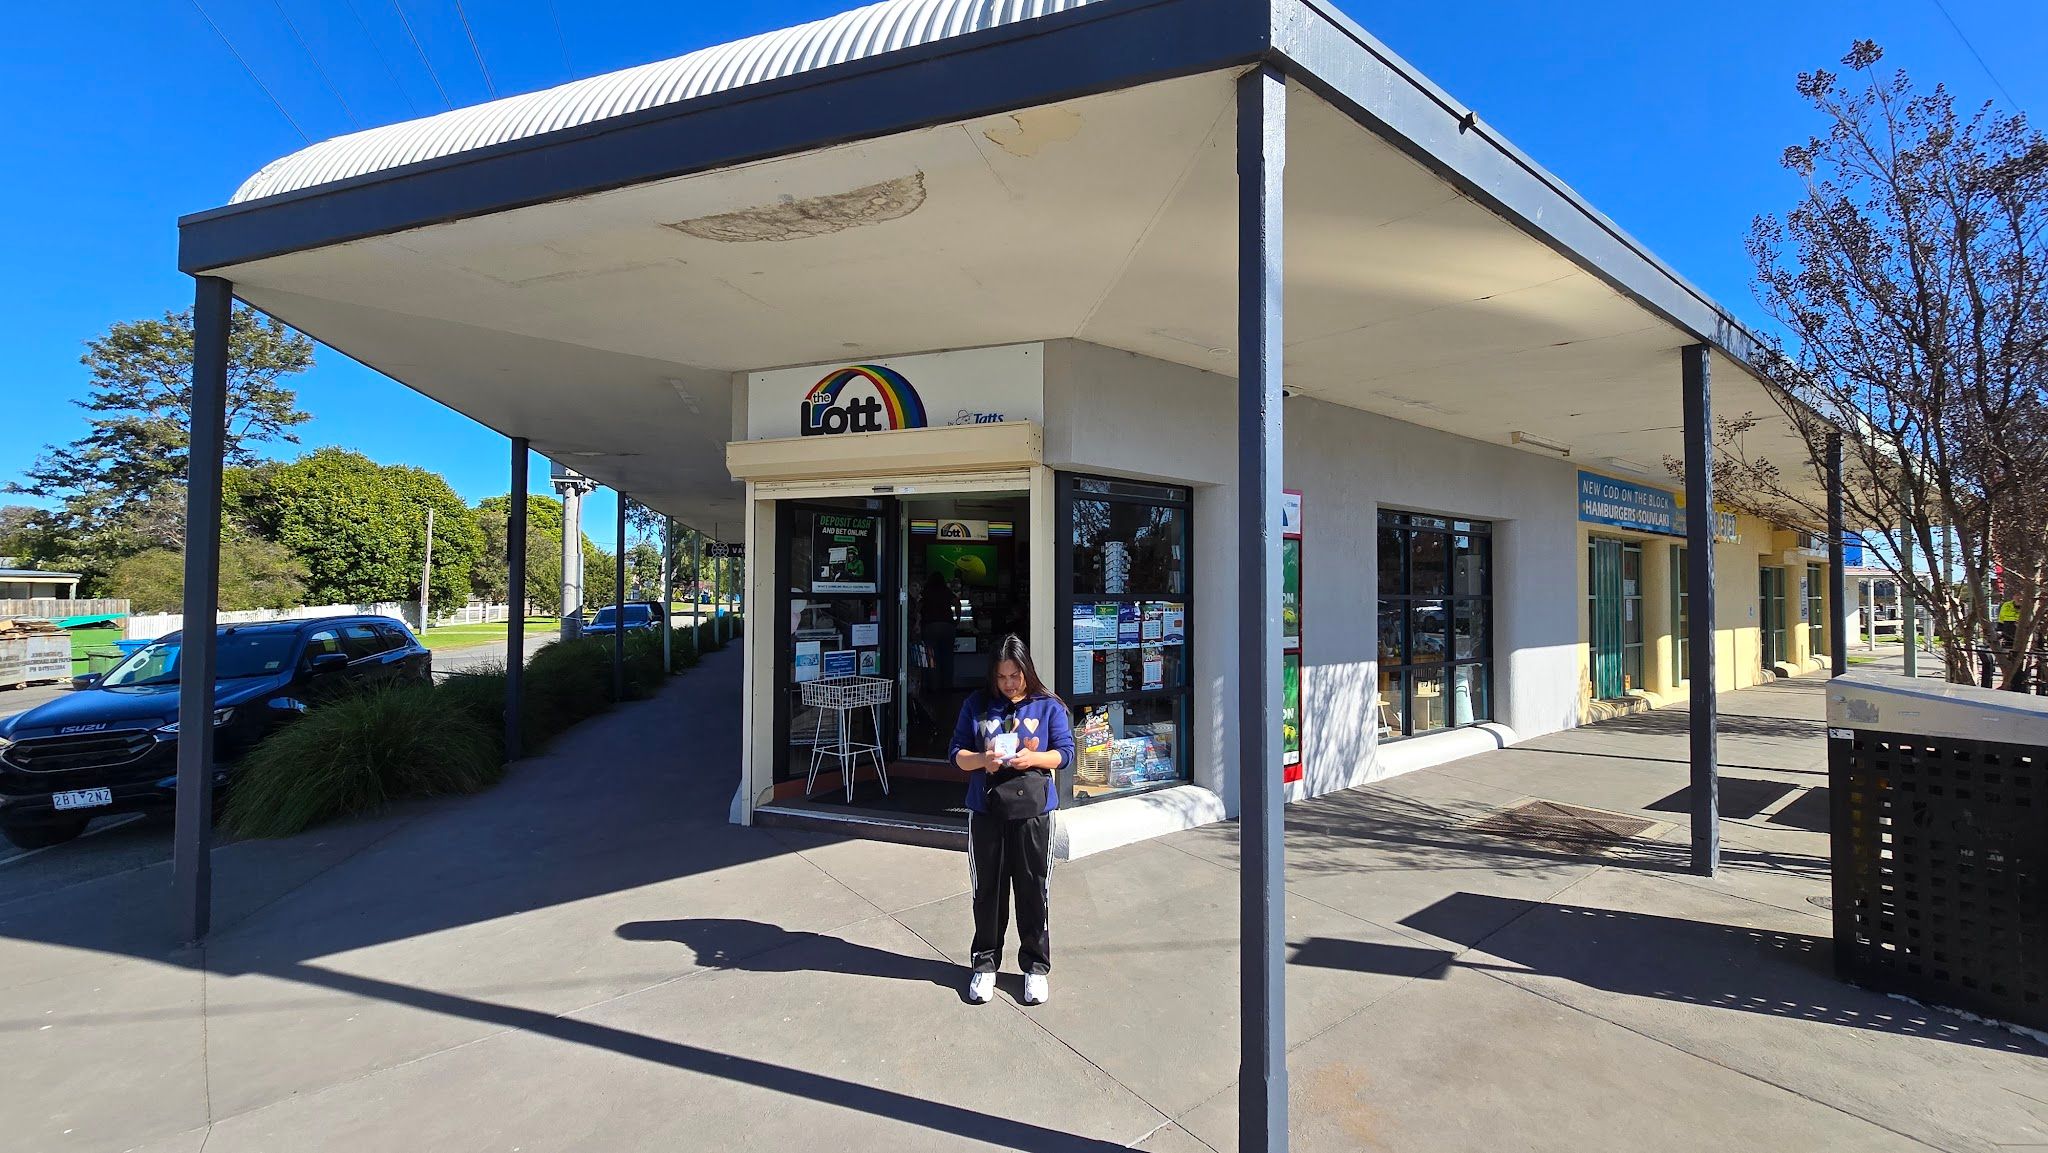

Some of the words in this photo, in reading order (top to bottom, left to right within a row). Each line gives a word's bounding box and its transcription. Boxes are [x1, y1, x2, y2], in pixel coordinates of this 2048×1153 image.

[812, 391, 831, 404] the
[800, 396, 882, 437] Lott
[973, 412, 1004, 424] Tatts
[1582, 480, 1601, 496] NEW
[1603, 484, 1620, 500] COD
[1621, 488, 1632, 502] ON
[1634, 491, 1647, 505] THE
[1648, 494, 1669, 509] BLOCK
[1585, 500, 1636, 522] HAMBURGERS
[1638, 509, 1670, 527] SOUVLAKI
[820, 515, 851, 528] DEPOSIT
[852, 518, 871, 529] CASH
[822, 527, 835, 535] AND
[847, 529, 868, 537] ONLINE
[61, 723, 107, 734] ISUZU
